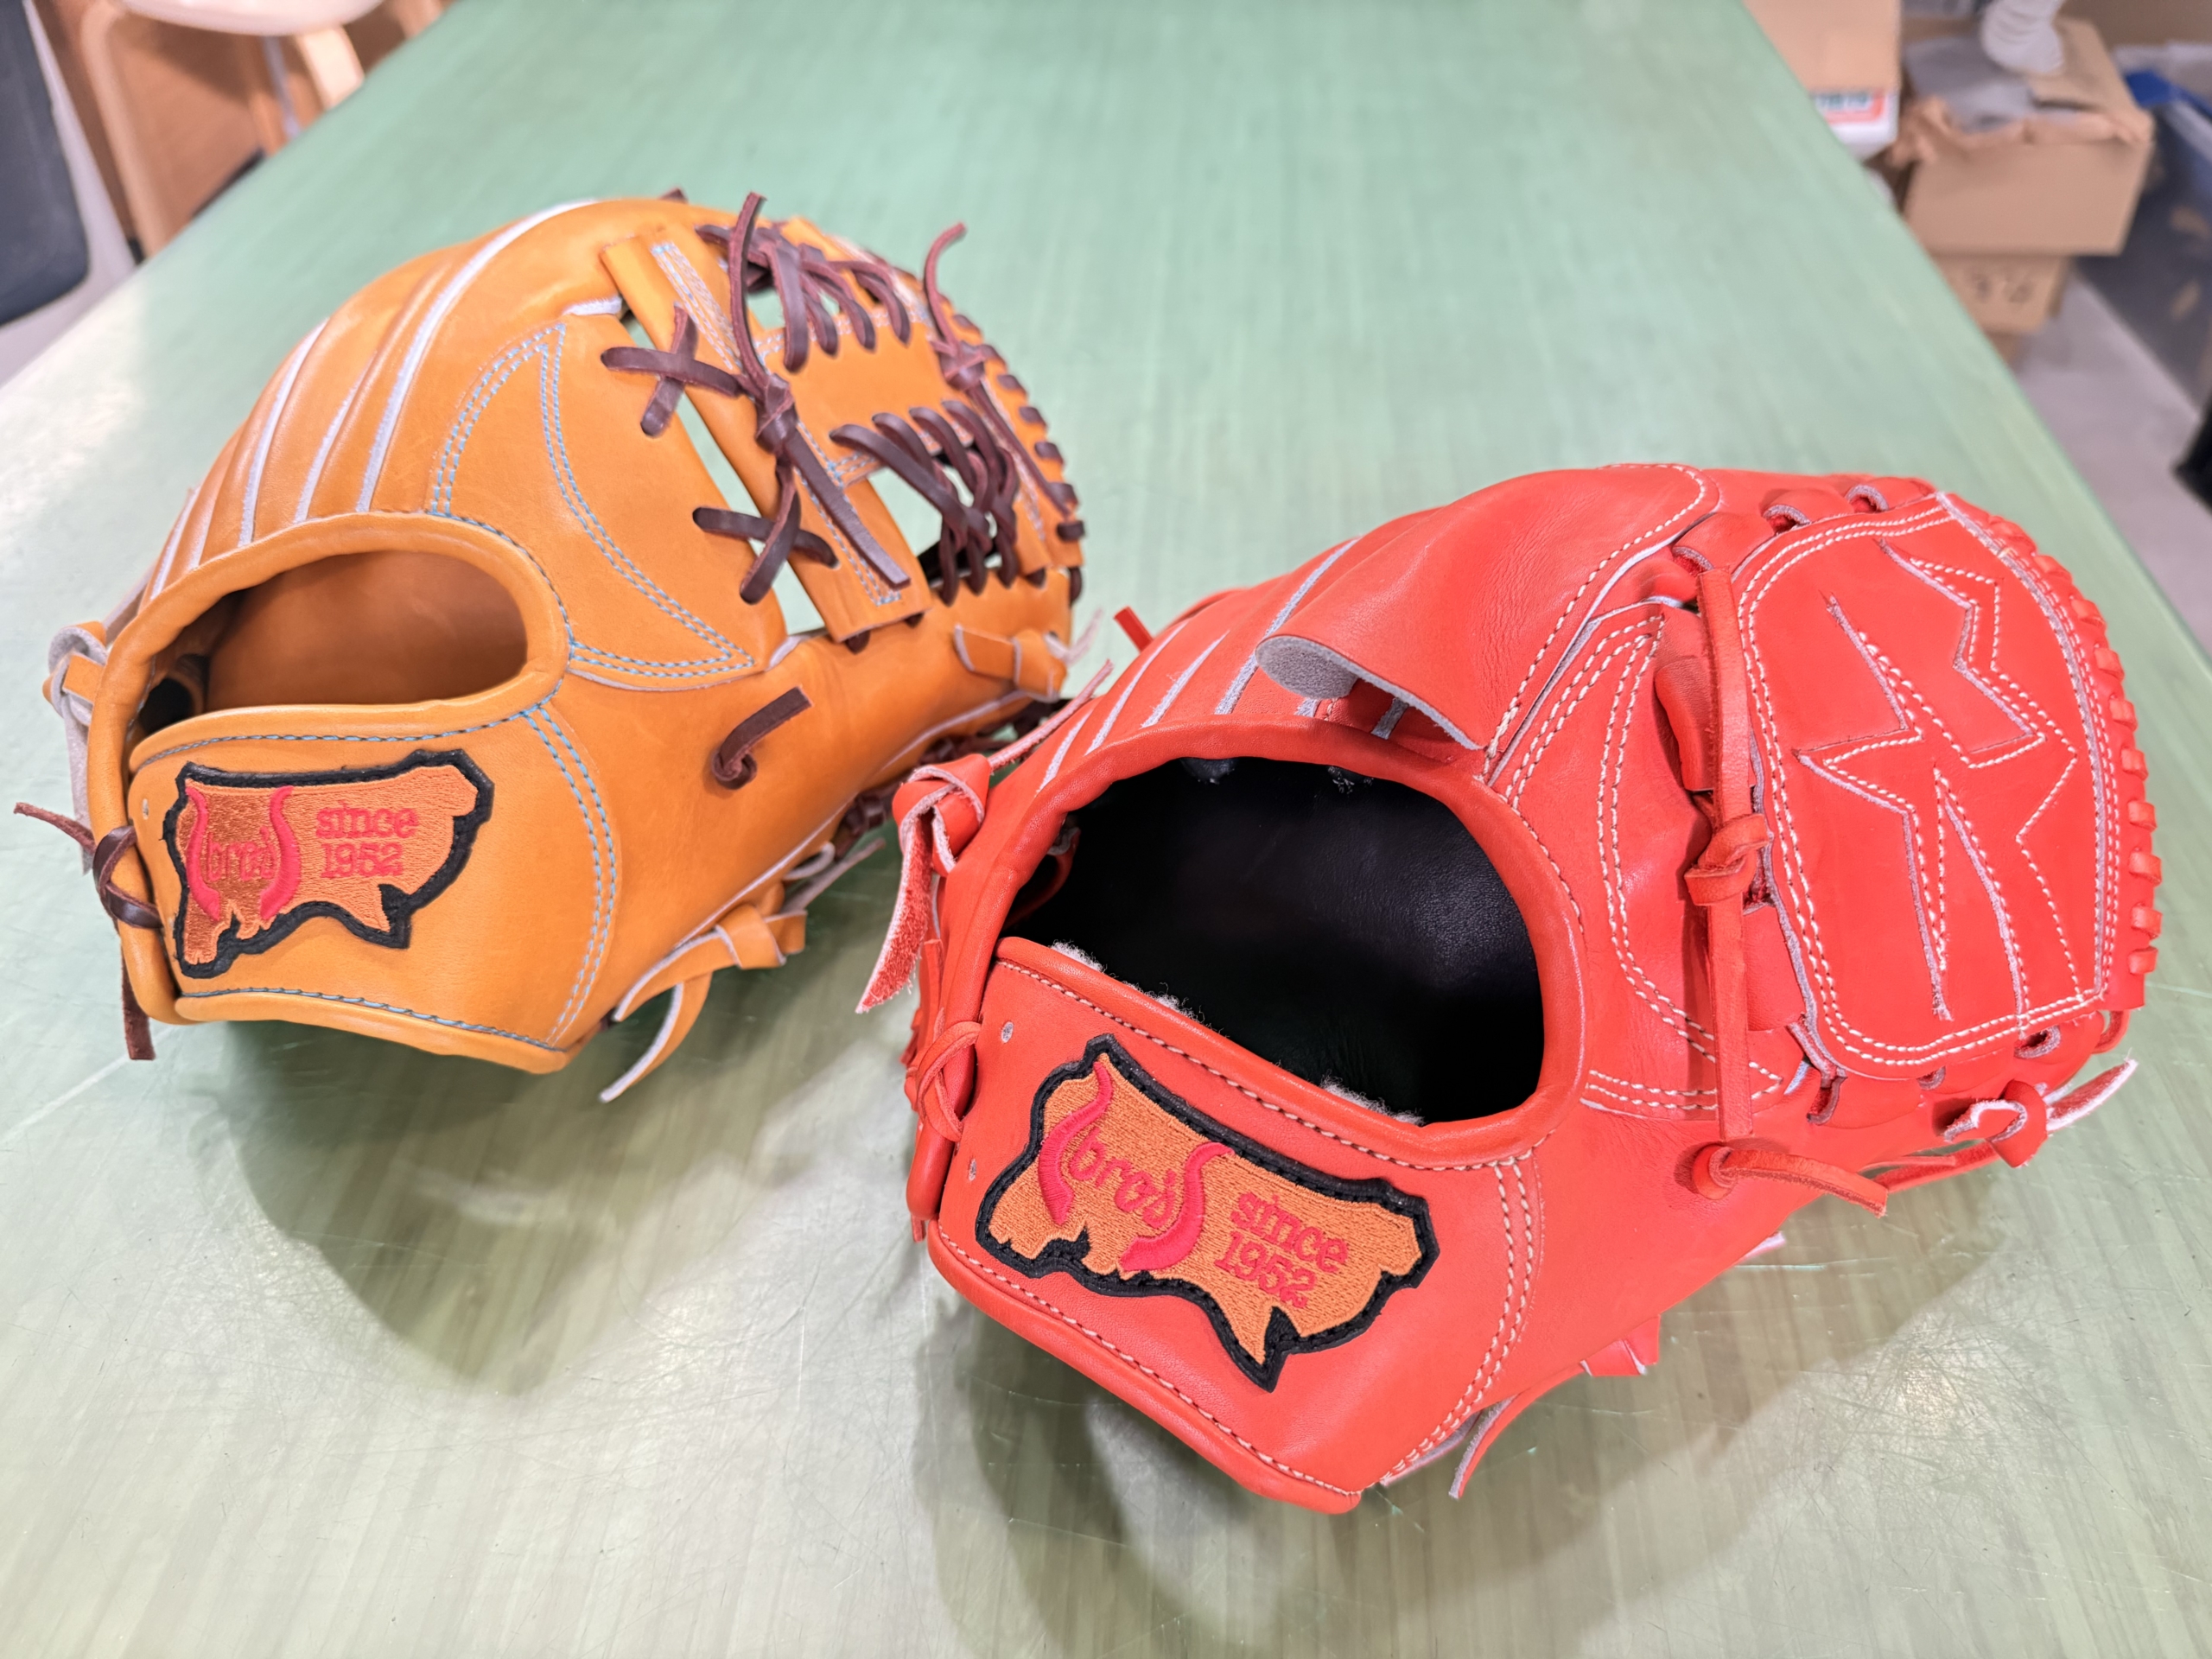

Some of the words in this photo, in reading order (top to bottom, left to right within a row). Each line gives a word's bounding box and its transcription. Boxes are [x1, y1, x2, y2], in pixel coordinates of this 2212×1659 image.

[315, 798, 420, 840] since
[320, 842, 404, 880] 1952
[1230, 1191, 1349, 1274] since
[1213, 1231, 1318, 1309] 1952
